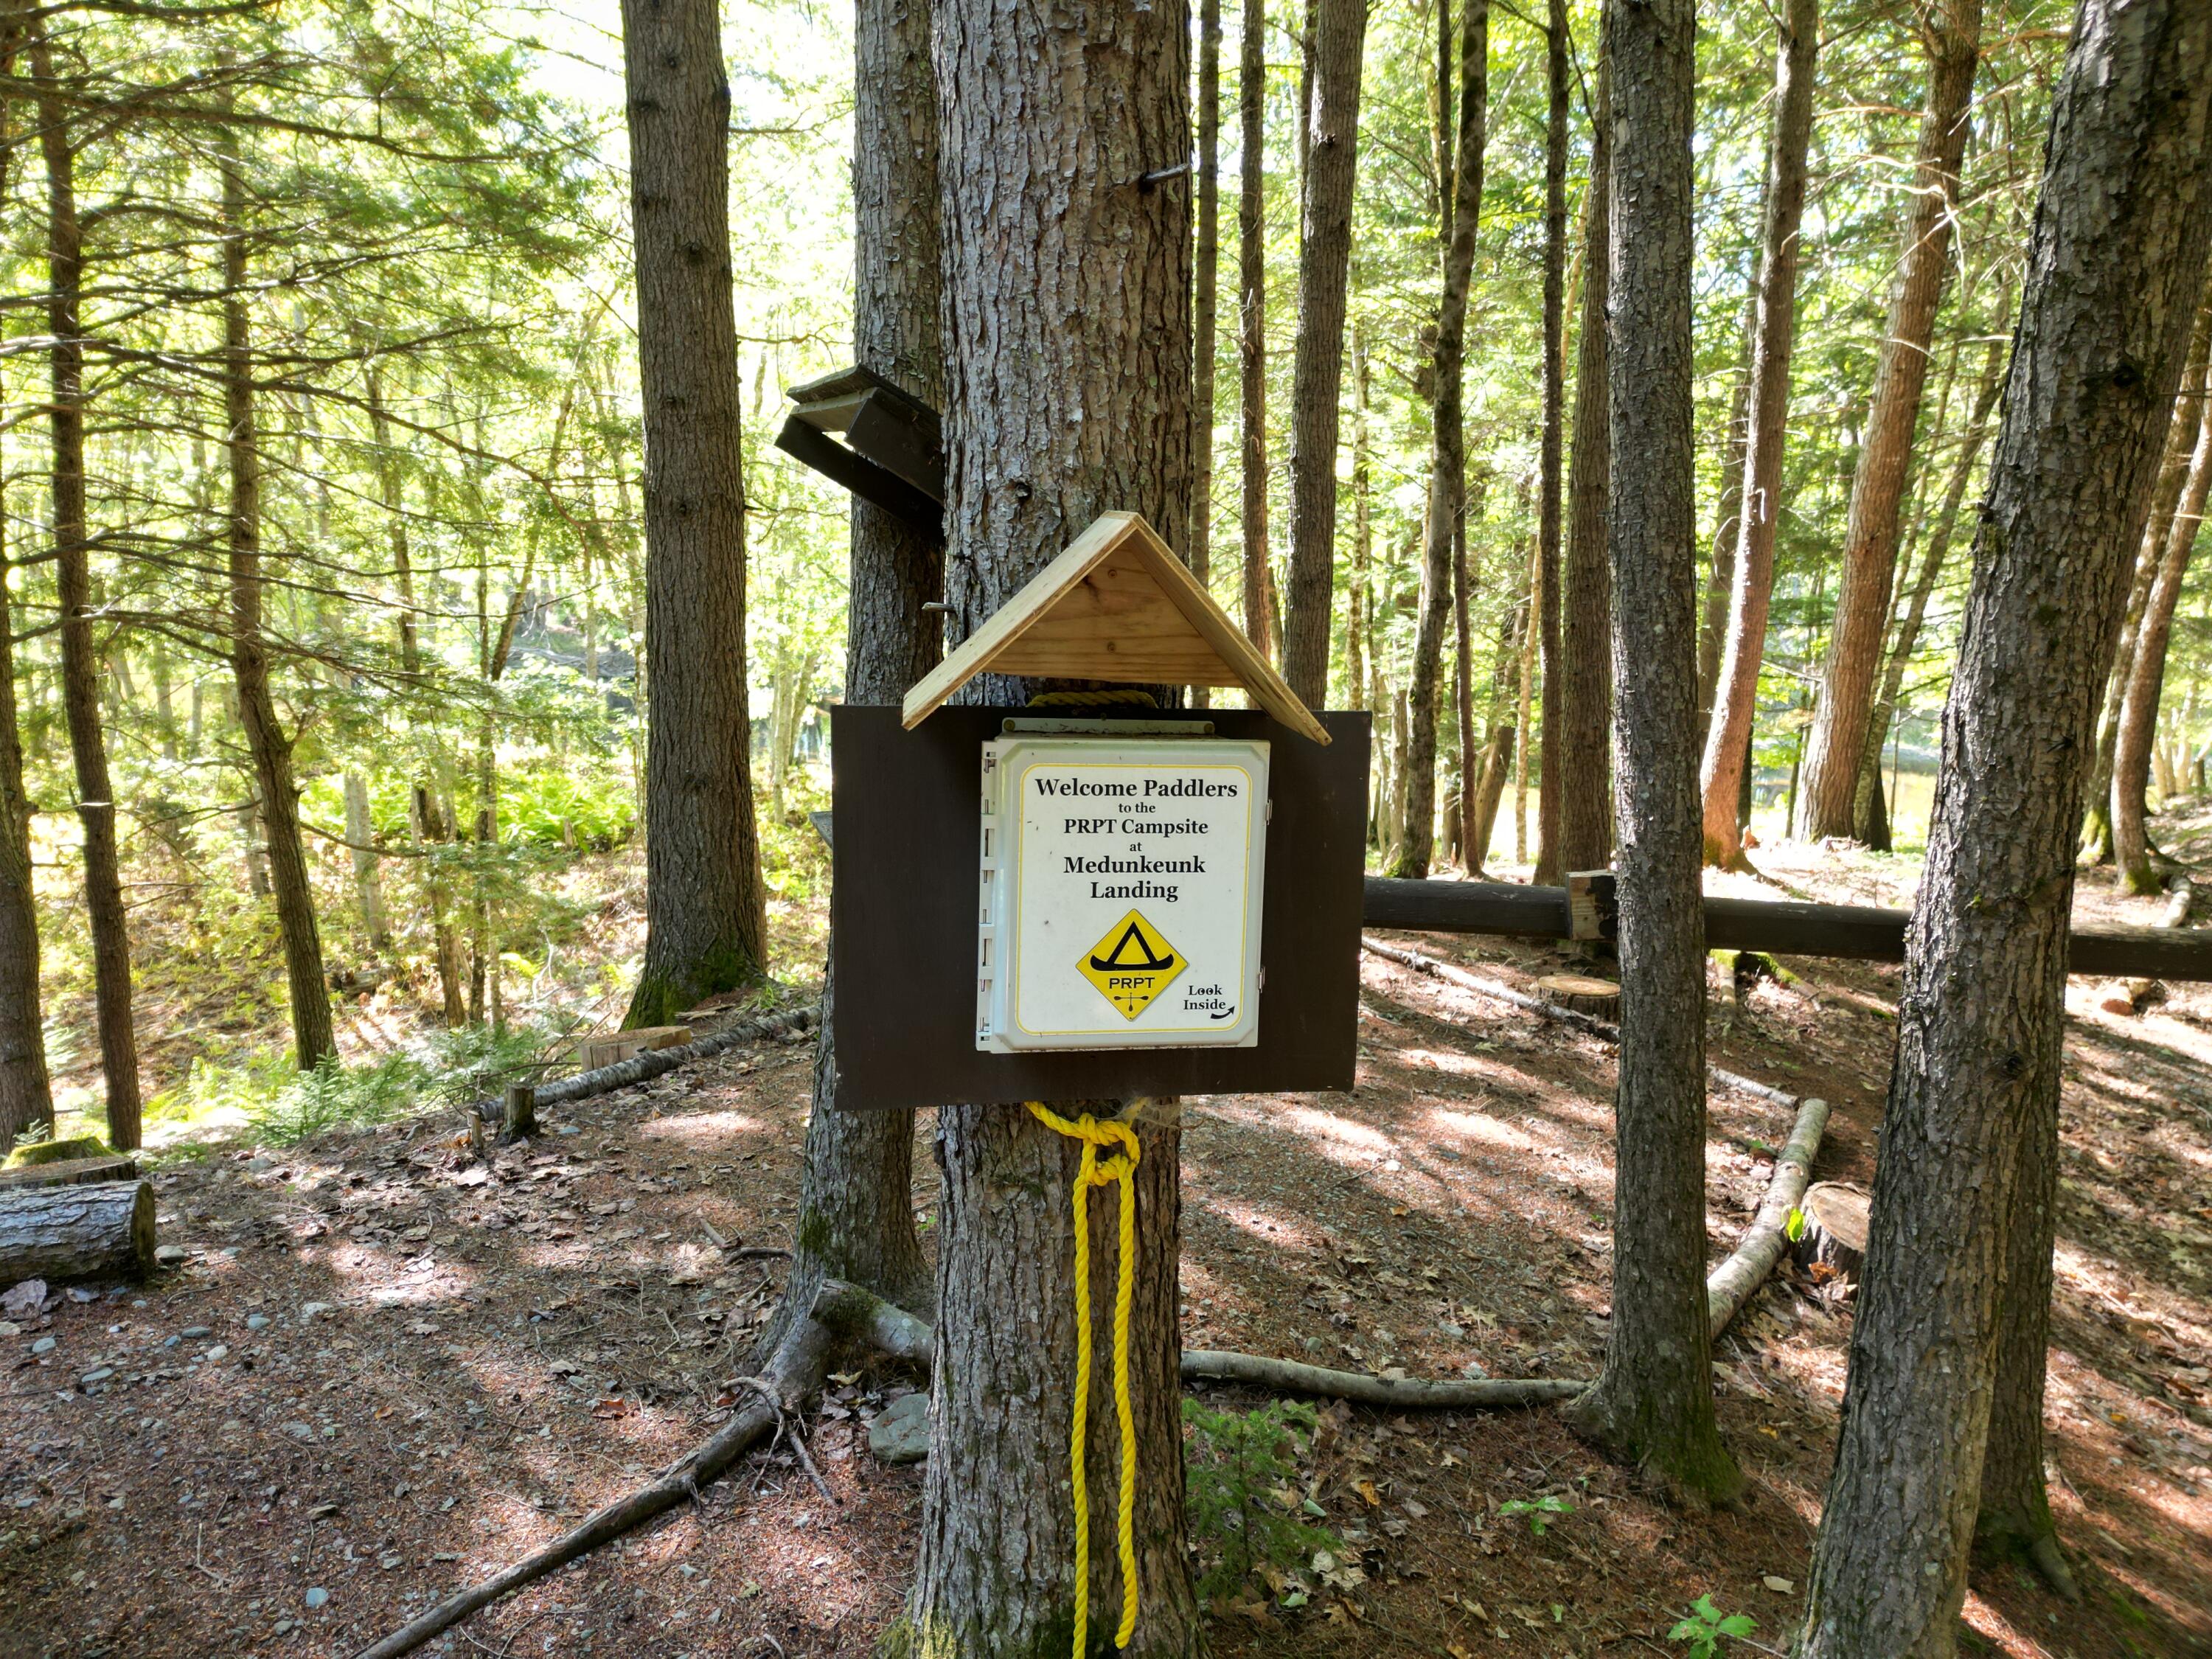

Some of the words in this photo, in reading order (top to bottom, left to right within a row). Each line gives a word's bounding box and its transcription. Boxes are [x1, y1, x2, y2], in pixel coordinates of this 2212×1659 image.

[1034, 777, 1137, 796] Welcome
[1143, 779, 1237, 797] Paddlers
[1118, 803, 1132, 813] to
[1135, 801, 1156, 813] the
[1064, 818, 1117, 834] PRPT
[1121, 818, 1208, 838] Campsite
[1129, 842, 1142, 852] at
[1063, 855, 1206, 874] Medunkeunk
[1091, 880, 1179, 902] Landing
[1109, 977, 1155, 990] PRPT
[1189, 984, 1222, 995] Look
[1183, 998, 1226, 1010] Inside
